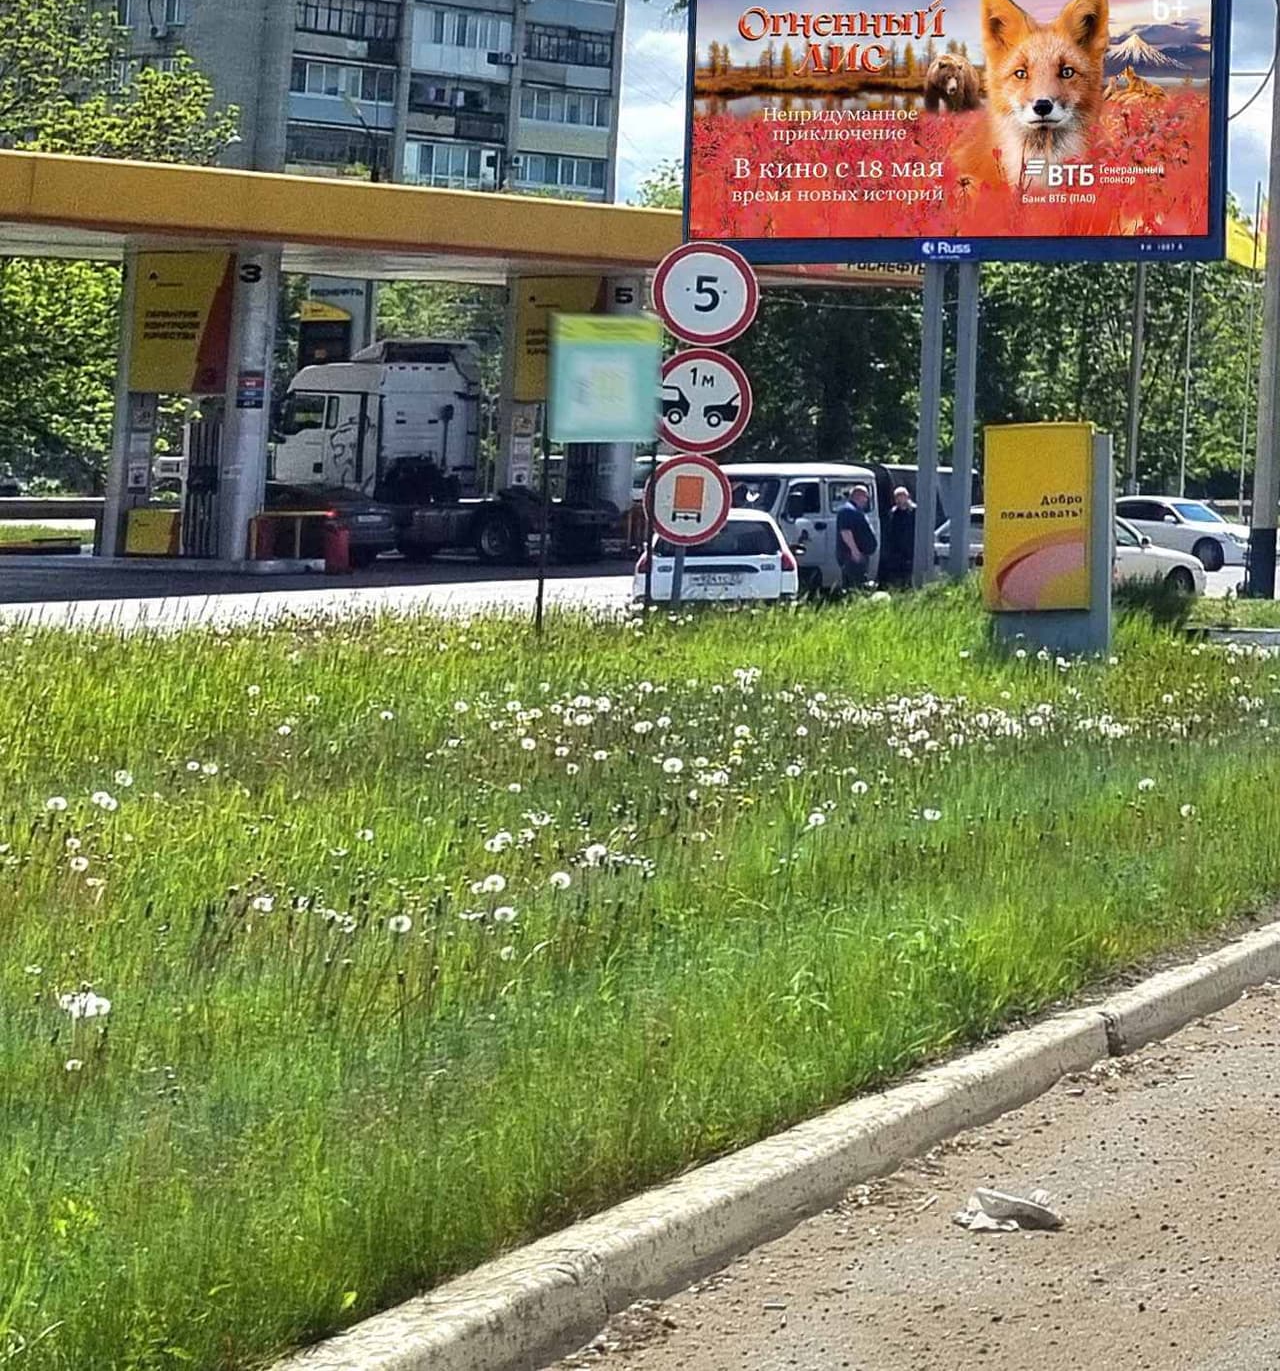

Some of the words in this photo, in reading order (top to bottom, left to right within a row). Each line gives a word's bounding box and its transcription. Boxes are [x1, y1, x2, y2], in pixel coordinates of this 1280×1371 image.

[763, 107, 918, 125] Непридуманное
[773, 127, 907, 144] приключение
[735, 158, 751, 178] В
[759, 162, 828, 178] кино
[835, 162, 849, 178] с
[857, 159, 883, 178] 18
[891, 161, 944, 178] мая
[1048, 164, 1095, 186] ВТБ
[1100, 163, 1165, 175] Генеральный
[1100, 176, 1136, 185] спонсор
[732, 190, 792, 205] время
[799, 188, 858, 202] новых
[863, 185, 944, 205] историй
[1022, 193, 1046, 203] Банк
[1049, 193, 1067, 203] ВТБ
[1069, 193, 1096, 205] (ПАО)
[937, 241, 972, 254] Russ
[240, 264, 261, 283] 3
[615, 287, 633, 304] 5
[694, 275, 720, 312] 5
[1041, 494, 1082, 506] Добро
[1001, 508, 1083, 519] пожаловать!
